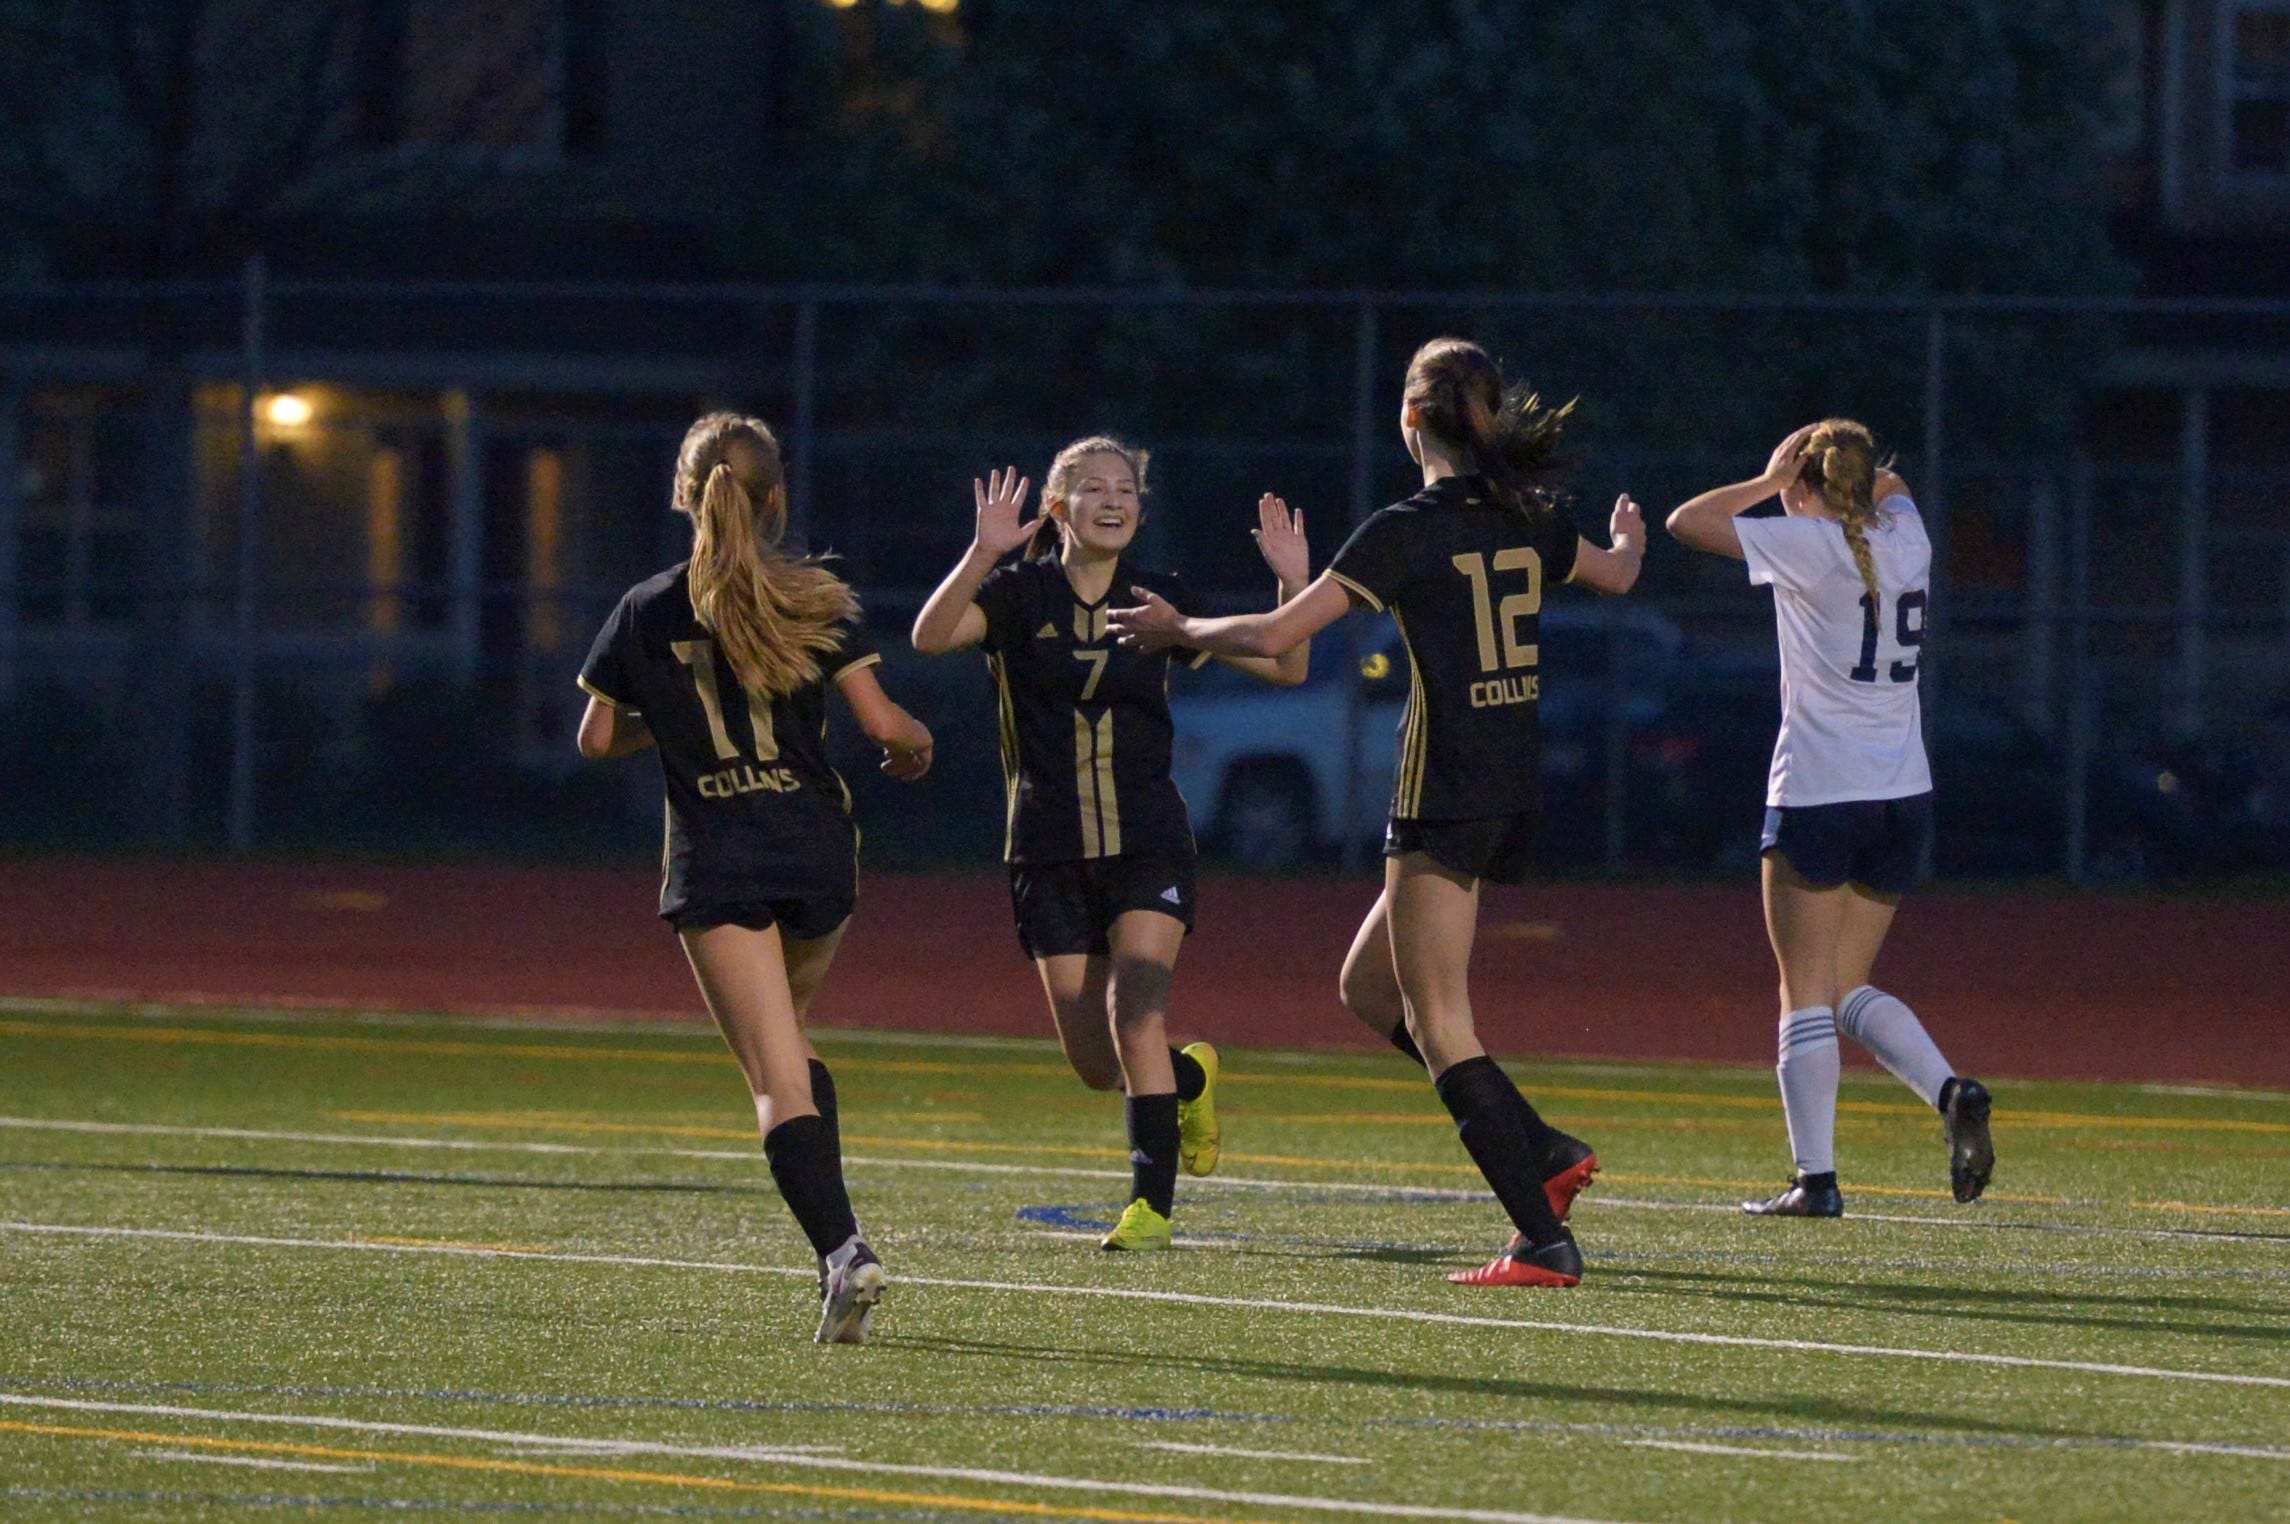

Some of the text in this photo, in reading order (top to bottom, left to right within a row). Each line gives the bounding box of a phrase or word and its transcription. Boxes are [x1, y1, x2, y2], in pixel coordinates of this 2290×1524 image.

[1452, 547, 1541, 672] 12
[1850, 589, 1927, 683] 19
[1073, 650, 1108, 700] 7
